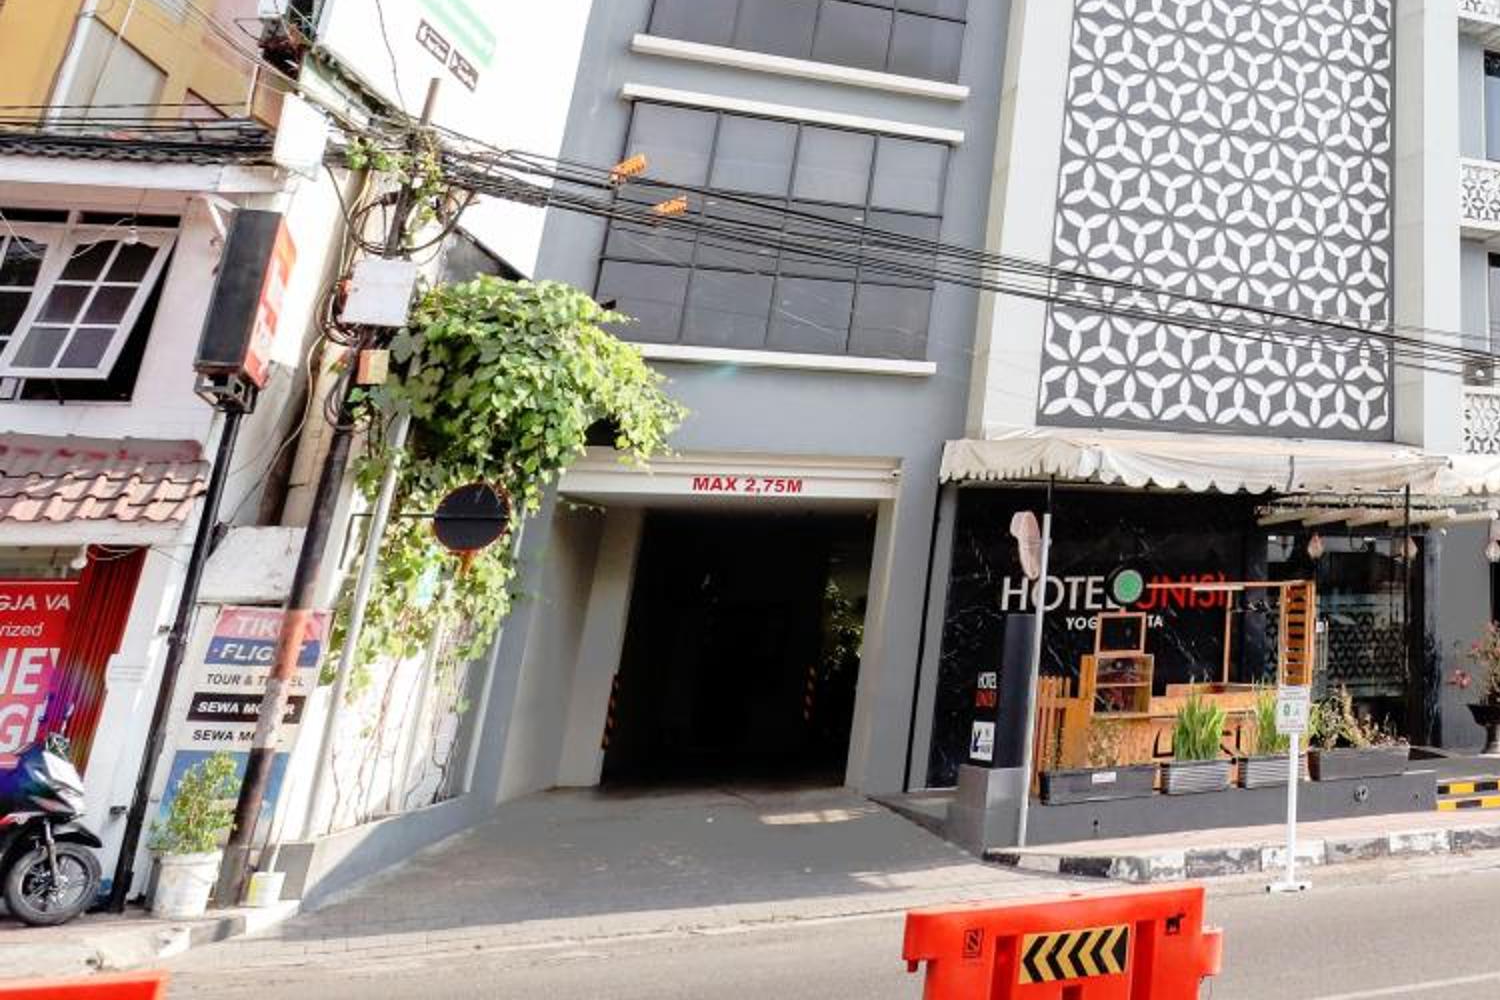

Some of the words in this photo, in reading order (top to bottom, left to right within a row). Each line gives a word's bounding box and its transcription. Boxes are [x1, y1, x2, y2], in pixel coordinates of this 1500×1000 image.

[692, 477, 738, 491] MAX
[207, 673, 241, 686] TOUR
[197, 701, 240, 713] SEWA
[193, 729, 234, 741] SEWA
